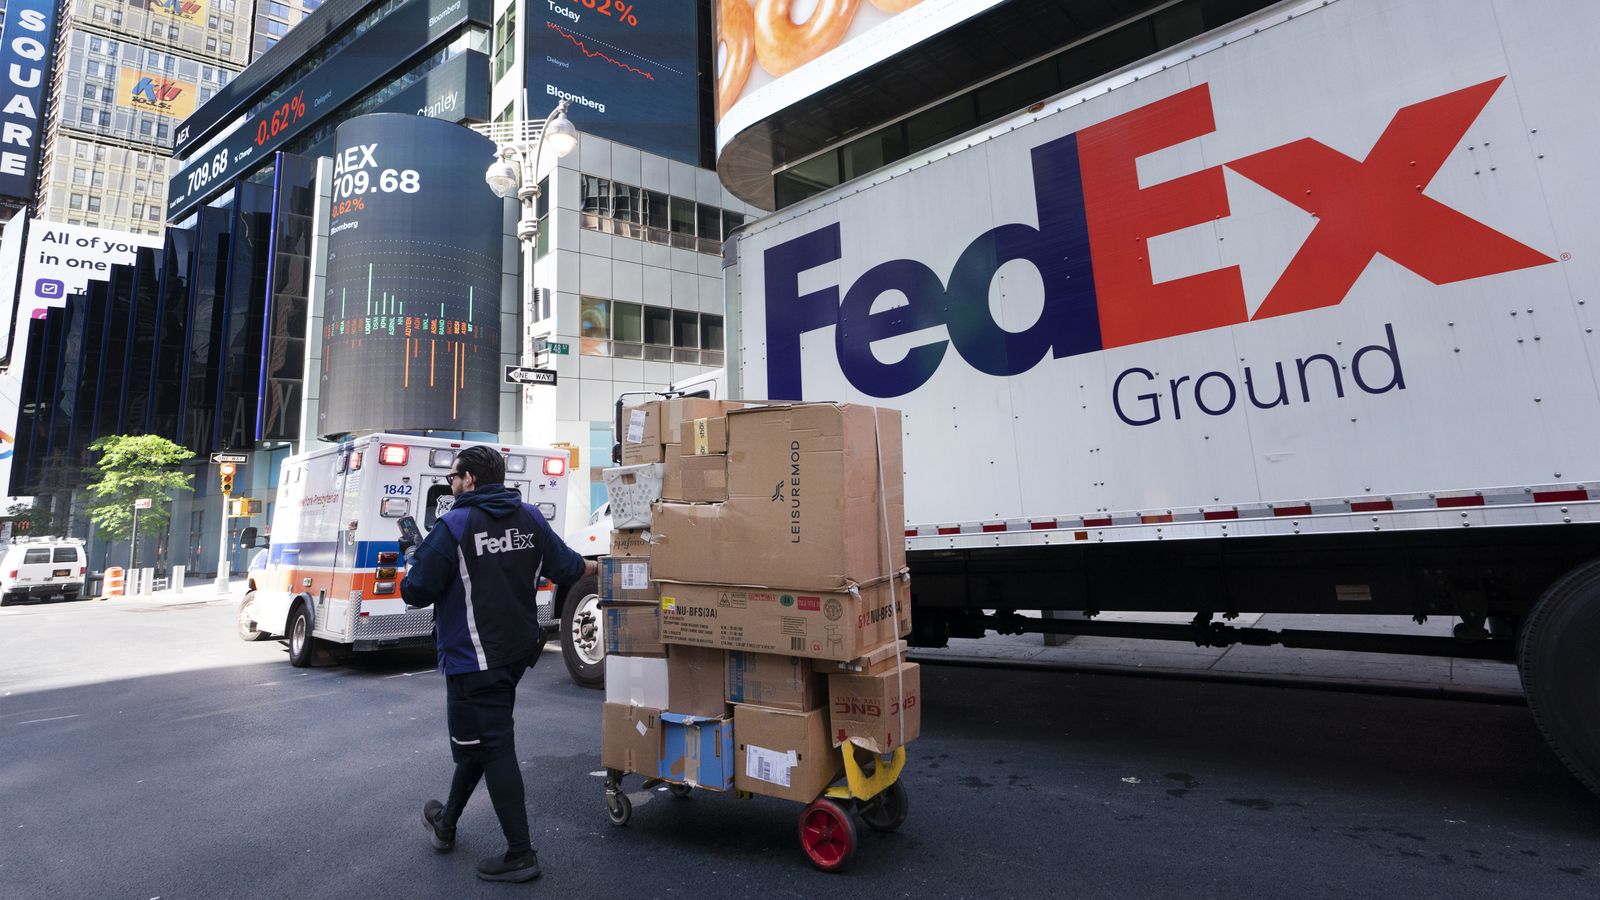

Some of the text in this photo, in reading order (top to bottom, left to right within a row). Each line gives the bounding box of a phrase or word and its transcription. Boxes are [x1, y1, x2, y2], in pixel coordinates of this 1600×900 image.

[429, 1, 461, 27] Bloomberg
[547, 0, 581, 23] Today
[1, 9, 46, 176] SQUARE
[546, 84, 605, 113] Bloomberg
[175, 125, 191, 147] AEX
[187, 148, 229, 197] 709.68
[254, 89, 305, 146] -0.62%
[334, 143, 378, 179] AEX
[333, 168, 421, 203] 709.68
[42, 231, 69, 245] All
[76, 236, 101, 248] of
[764, 75, 1558, 401] FedEx
[40, 251, 107, 271] in one
[404, 316, 412, 337] ADYEN
[513, 371, 551, 381] ONE WAY
[1113, 323, 1406, 426] Ground
[383, 484, 413, 495] 1842
[791, 440, 800, 544] LEISUREMOD
[474, 528, 535, 556] FedEx
[835, 702, 881, 717] GNC
